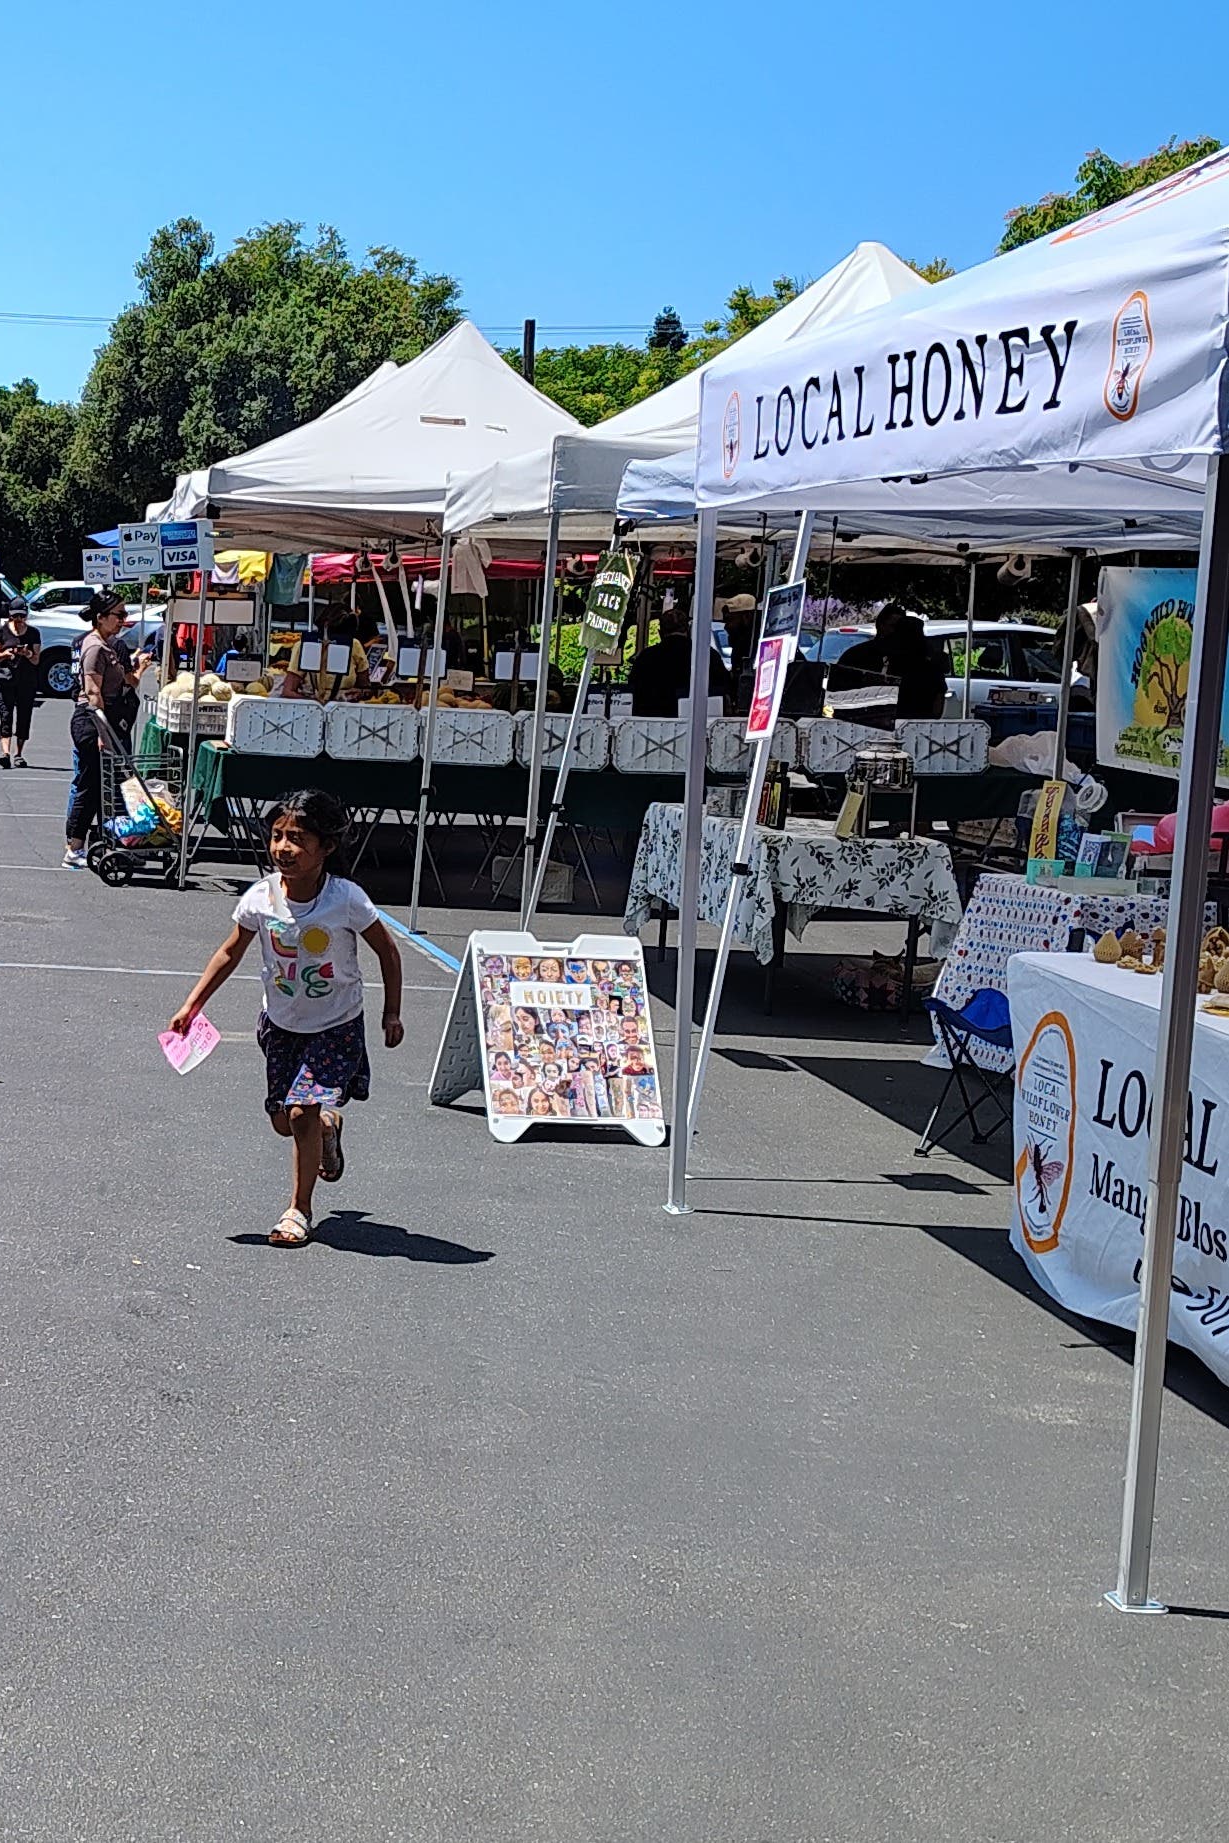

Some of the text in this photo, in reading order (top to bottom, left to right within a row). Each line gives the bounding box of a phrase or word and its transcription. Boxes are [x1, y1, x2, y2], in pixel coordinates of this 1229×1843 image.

[753, 320, 1078, 460] LOCAL HONEY
[134, 530, 158, 543] Pay
[126, 556, 154, 566] G Pay
[166, 550, 197, 562] VISA
[595, 592, 620, 610] FACE
[523, 989, 583, 1005] MOIETY
[1033, 1077, 1060, 1100] LOCAL
[1021, 1088, 1071, 1122] WILDFLOWER
[1028, 1109, 1058, 1133] HONEY
[1092, 1058, 1218, 1177] LOAL
